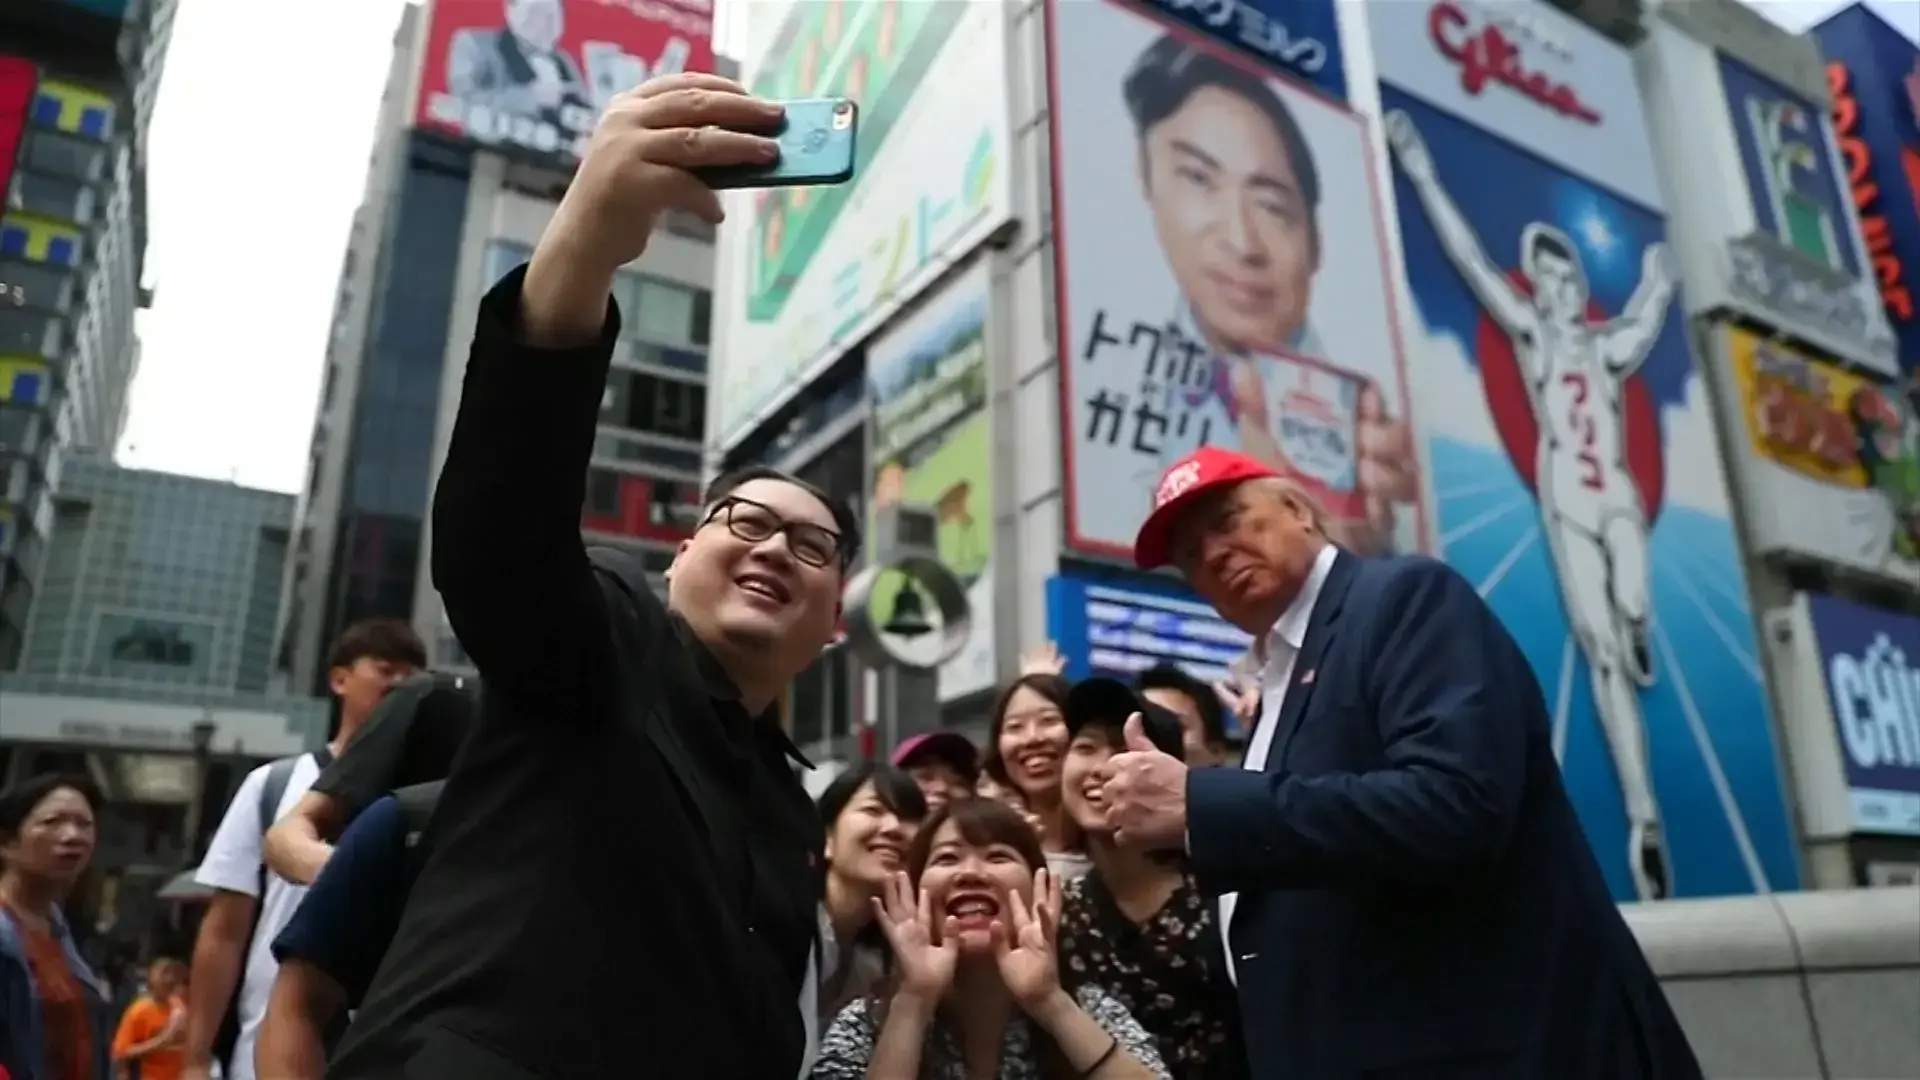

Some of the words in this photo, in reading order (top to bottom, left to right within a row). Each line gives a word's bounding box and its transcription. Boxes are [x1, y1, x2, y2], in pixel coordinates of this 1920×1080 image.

[1430, 0, 1603, 127] Glico
[1087, 386, 1213, 456] ガセリ
